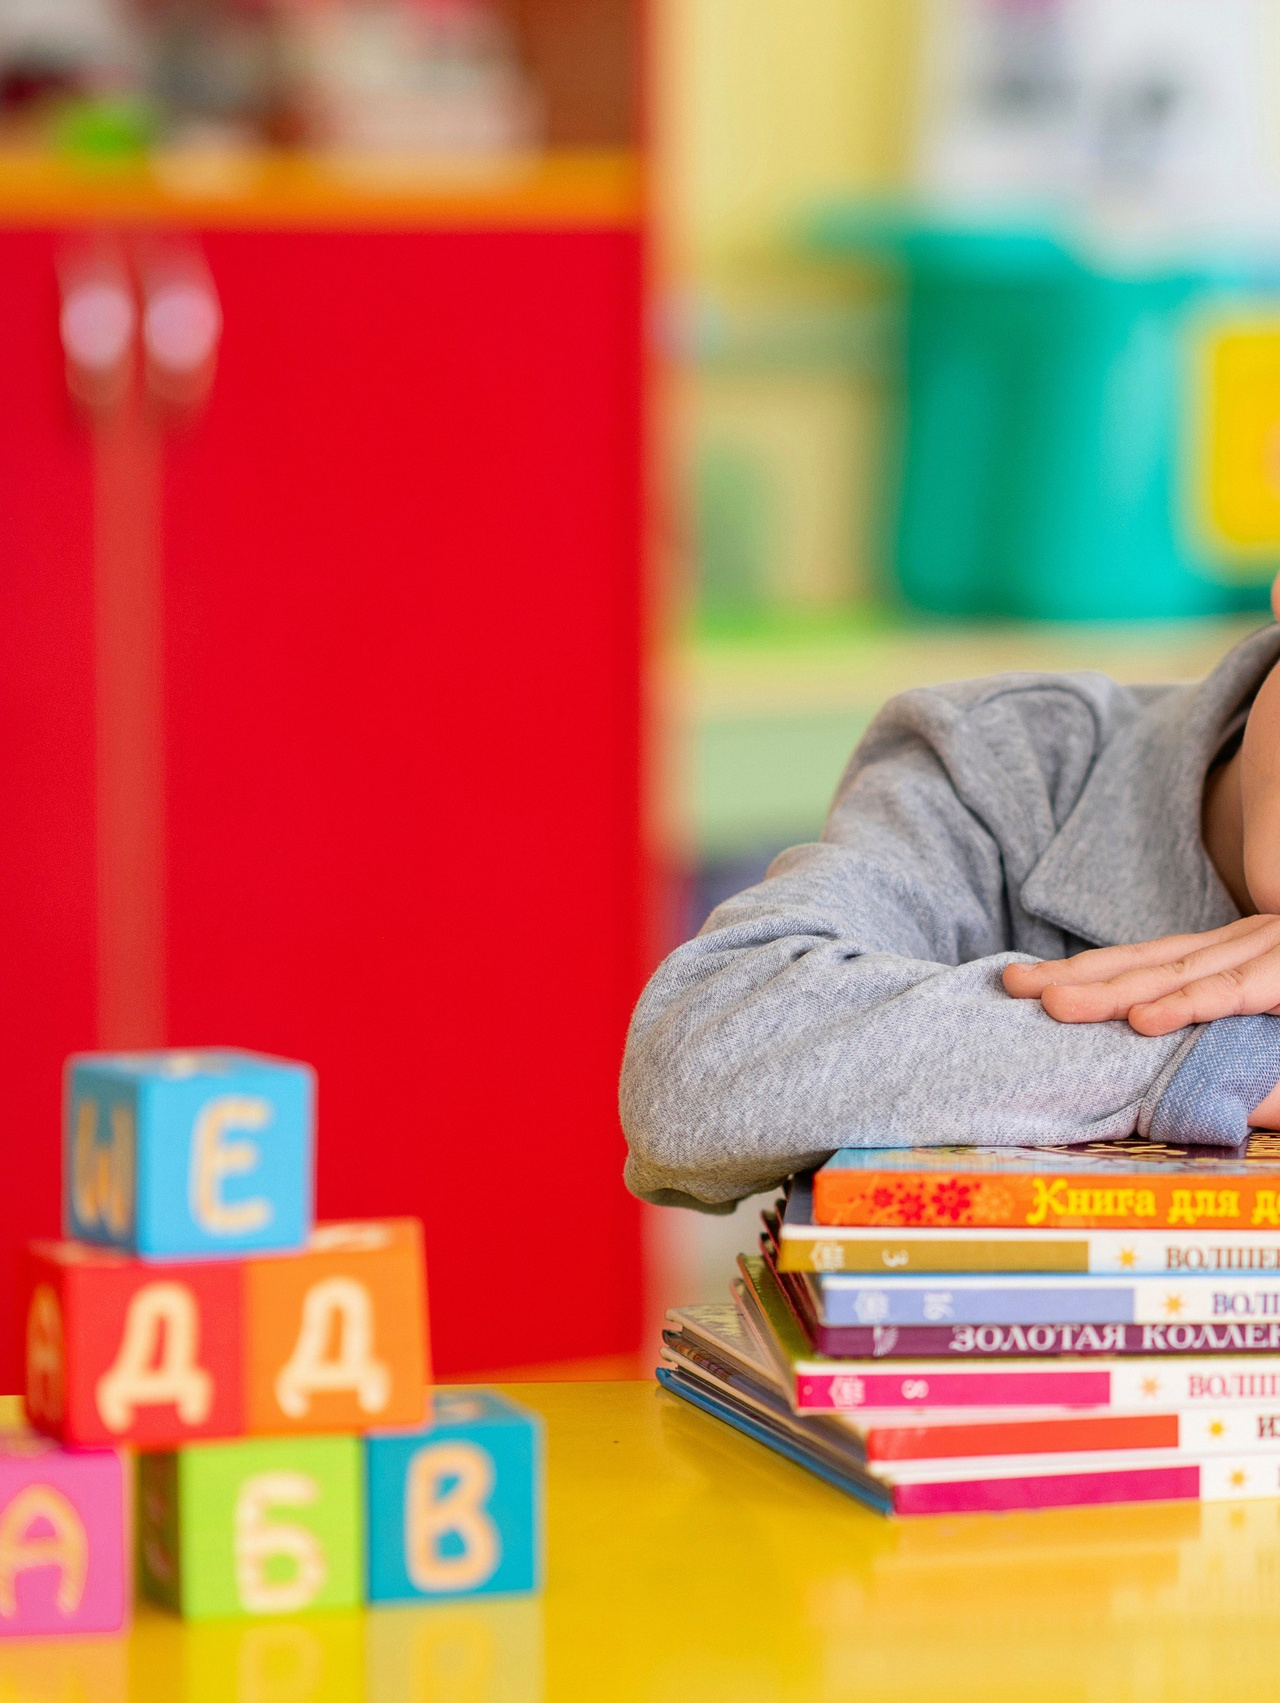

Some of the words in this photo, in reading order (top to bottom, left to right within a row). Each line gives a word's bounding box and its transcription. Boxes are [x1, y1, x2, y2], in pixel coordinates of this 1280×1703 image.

[190, 1094, 275, 1236] Е
[1026, 1177, 1155, 1226] Книга
[1167, 1187, 1241, 1225] для
[882, 1248, 909, 1267] 3
[96, 1281, 213, 1435] Д
[275, 1276, 393, 1420] Д
[901, 1379, 930, 1400] 8
[949, 1323, 1127, 1351] ЗОЛОТАЯ
[0, 1482, 90, 1620] А
[232, 1470, 327, 1618] Б
[403, 1441, 503, 1595] В
